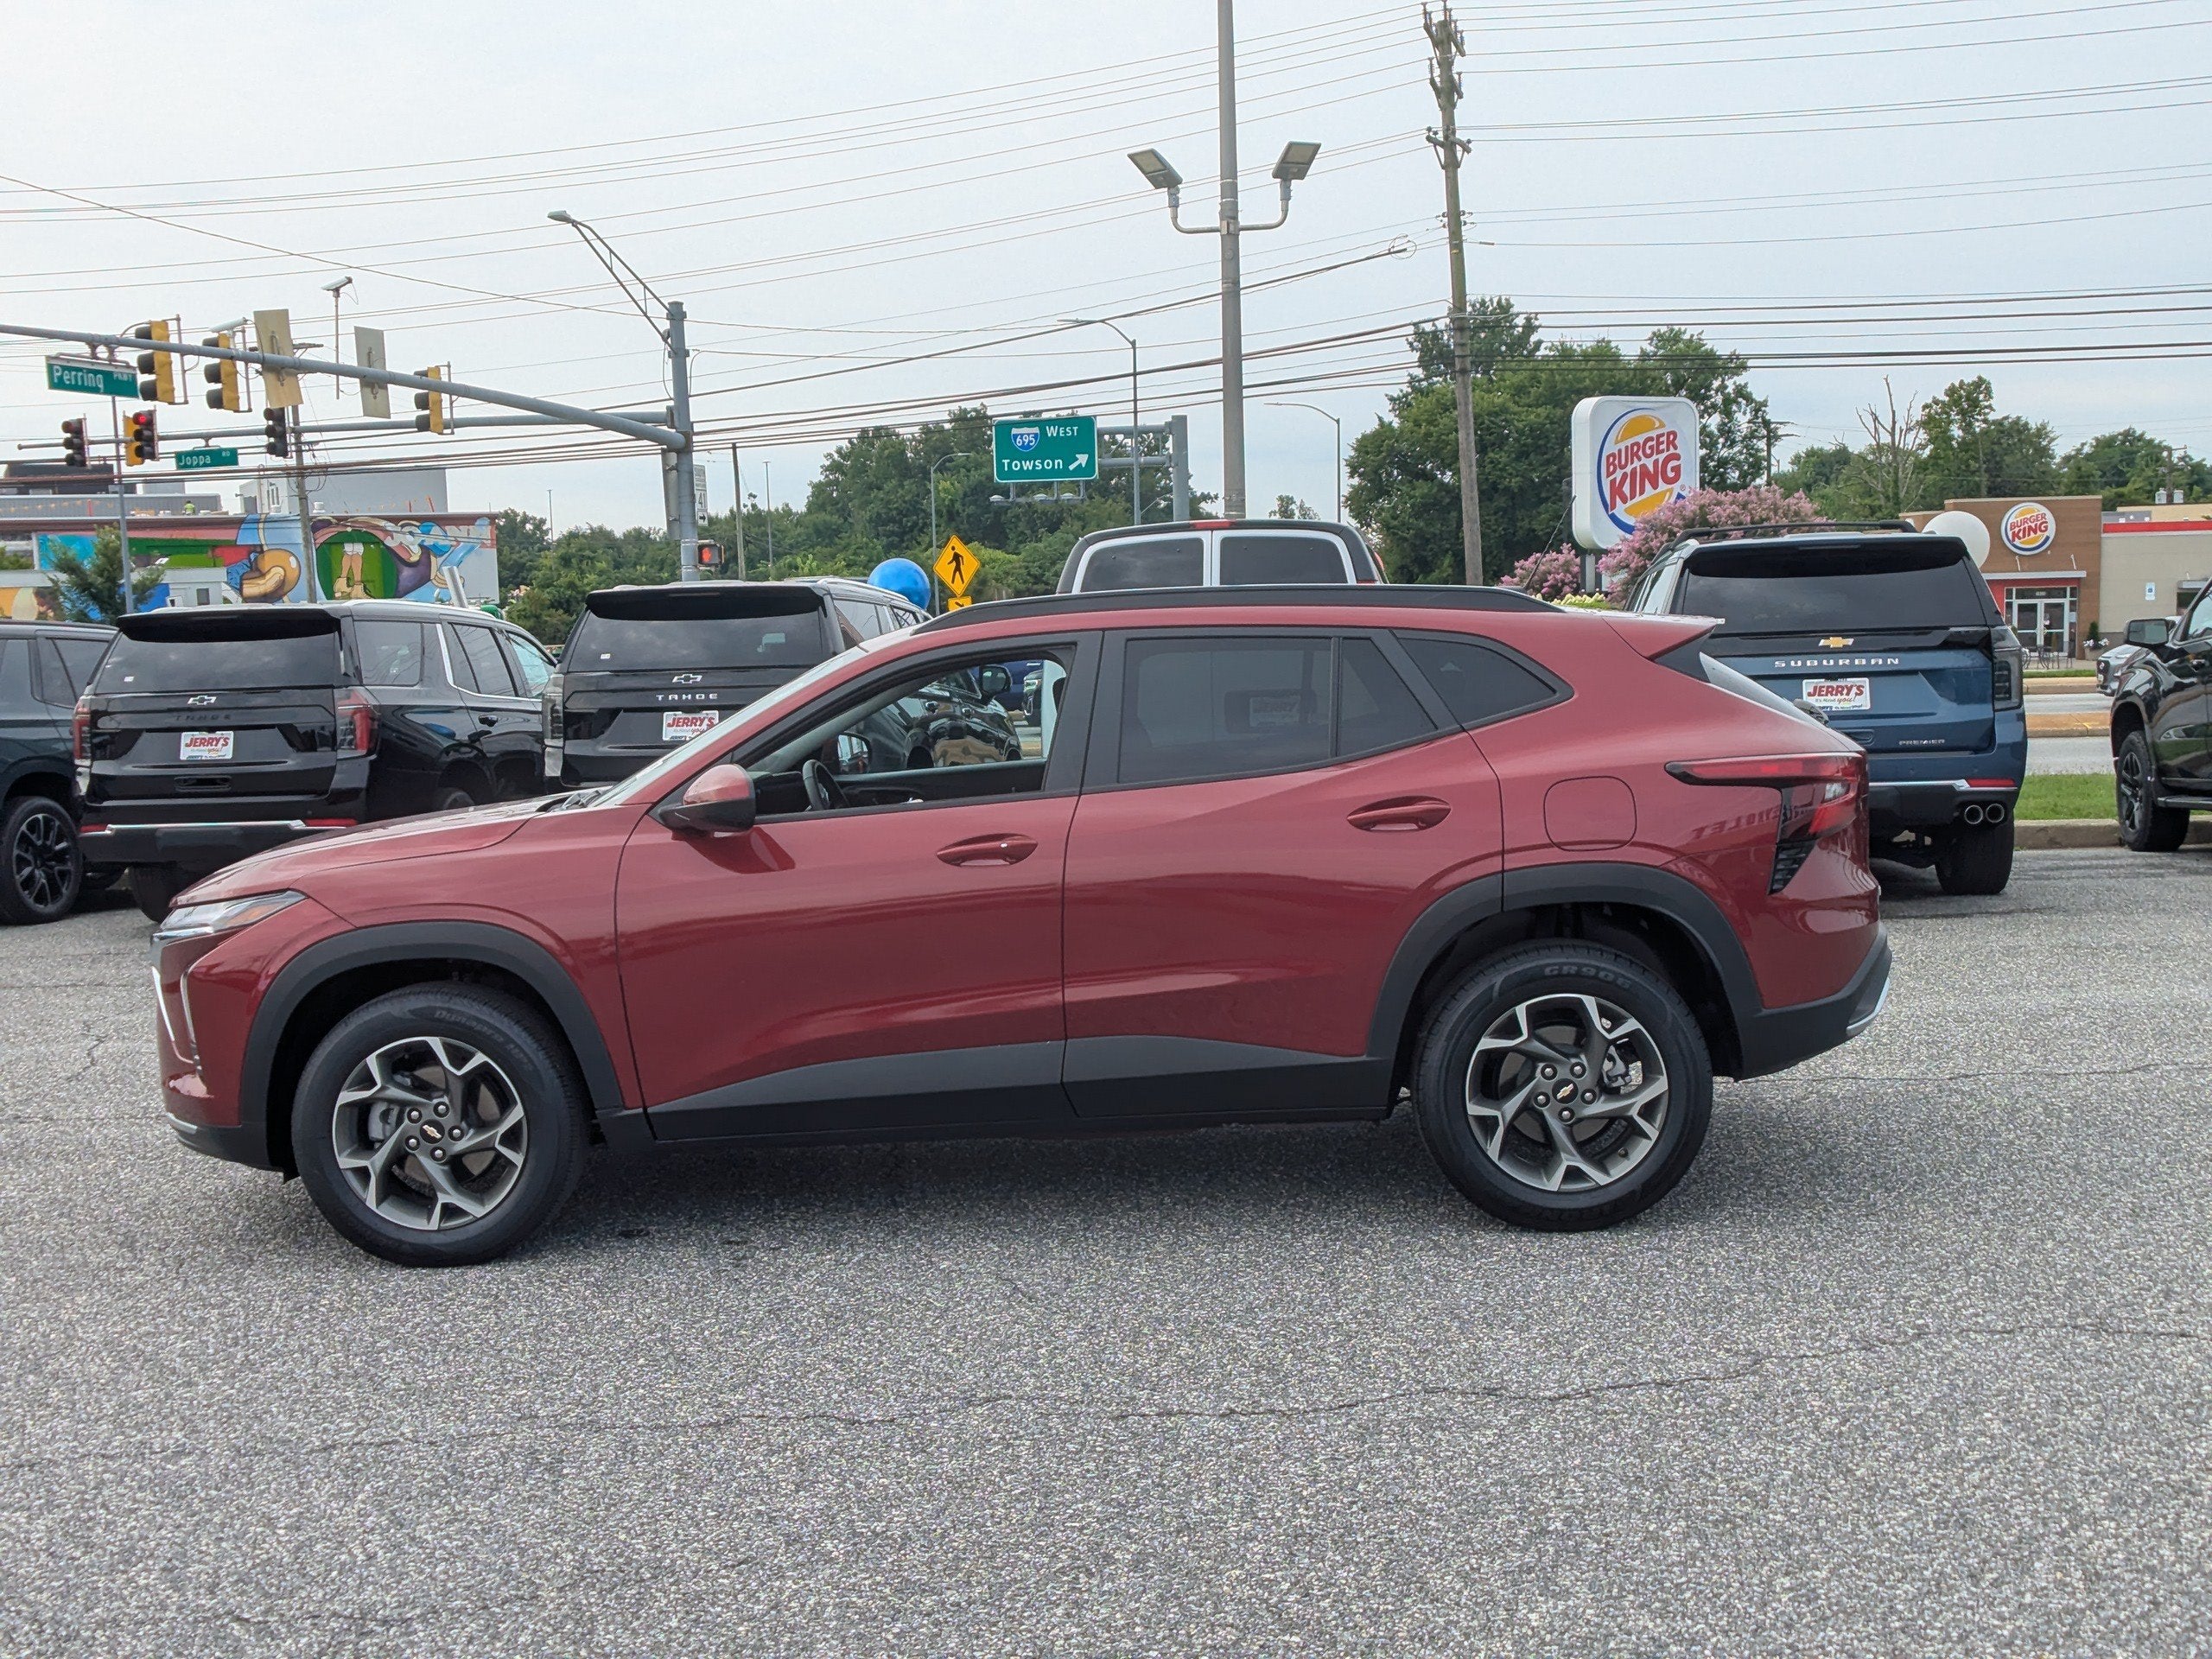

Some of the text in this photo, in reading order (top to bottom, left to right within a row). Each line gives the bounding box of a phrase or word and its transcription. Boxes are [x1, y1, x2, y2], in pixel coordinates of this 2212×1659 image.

[52, 365, 105, 393] Perring
[1015, 434, 1036, 447] 695
[178, 454, 212, 467] Joppa
[1605, 429, 1679, 479] BURGER
[1609, 452, 1682, 513] KING
[2009, 512, 2048, 532] BURGER
[2011, 520, 2050, 543] KING
[1774, 658, 1899, 668] SUBURBAN
[1807, 684, 1866, 697] JERRY'S
[666, 716, 715, 728] JERRY'S
[184, 736, 231, 748] JERRY'S
